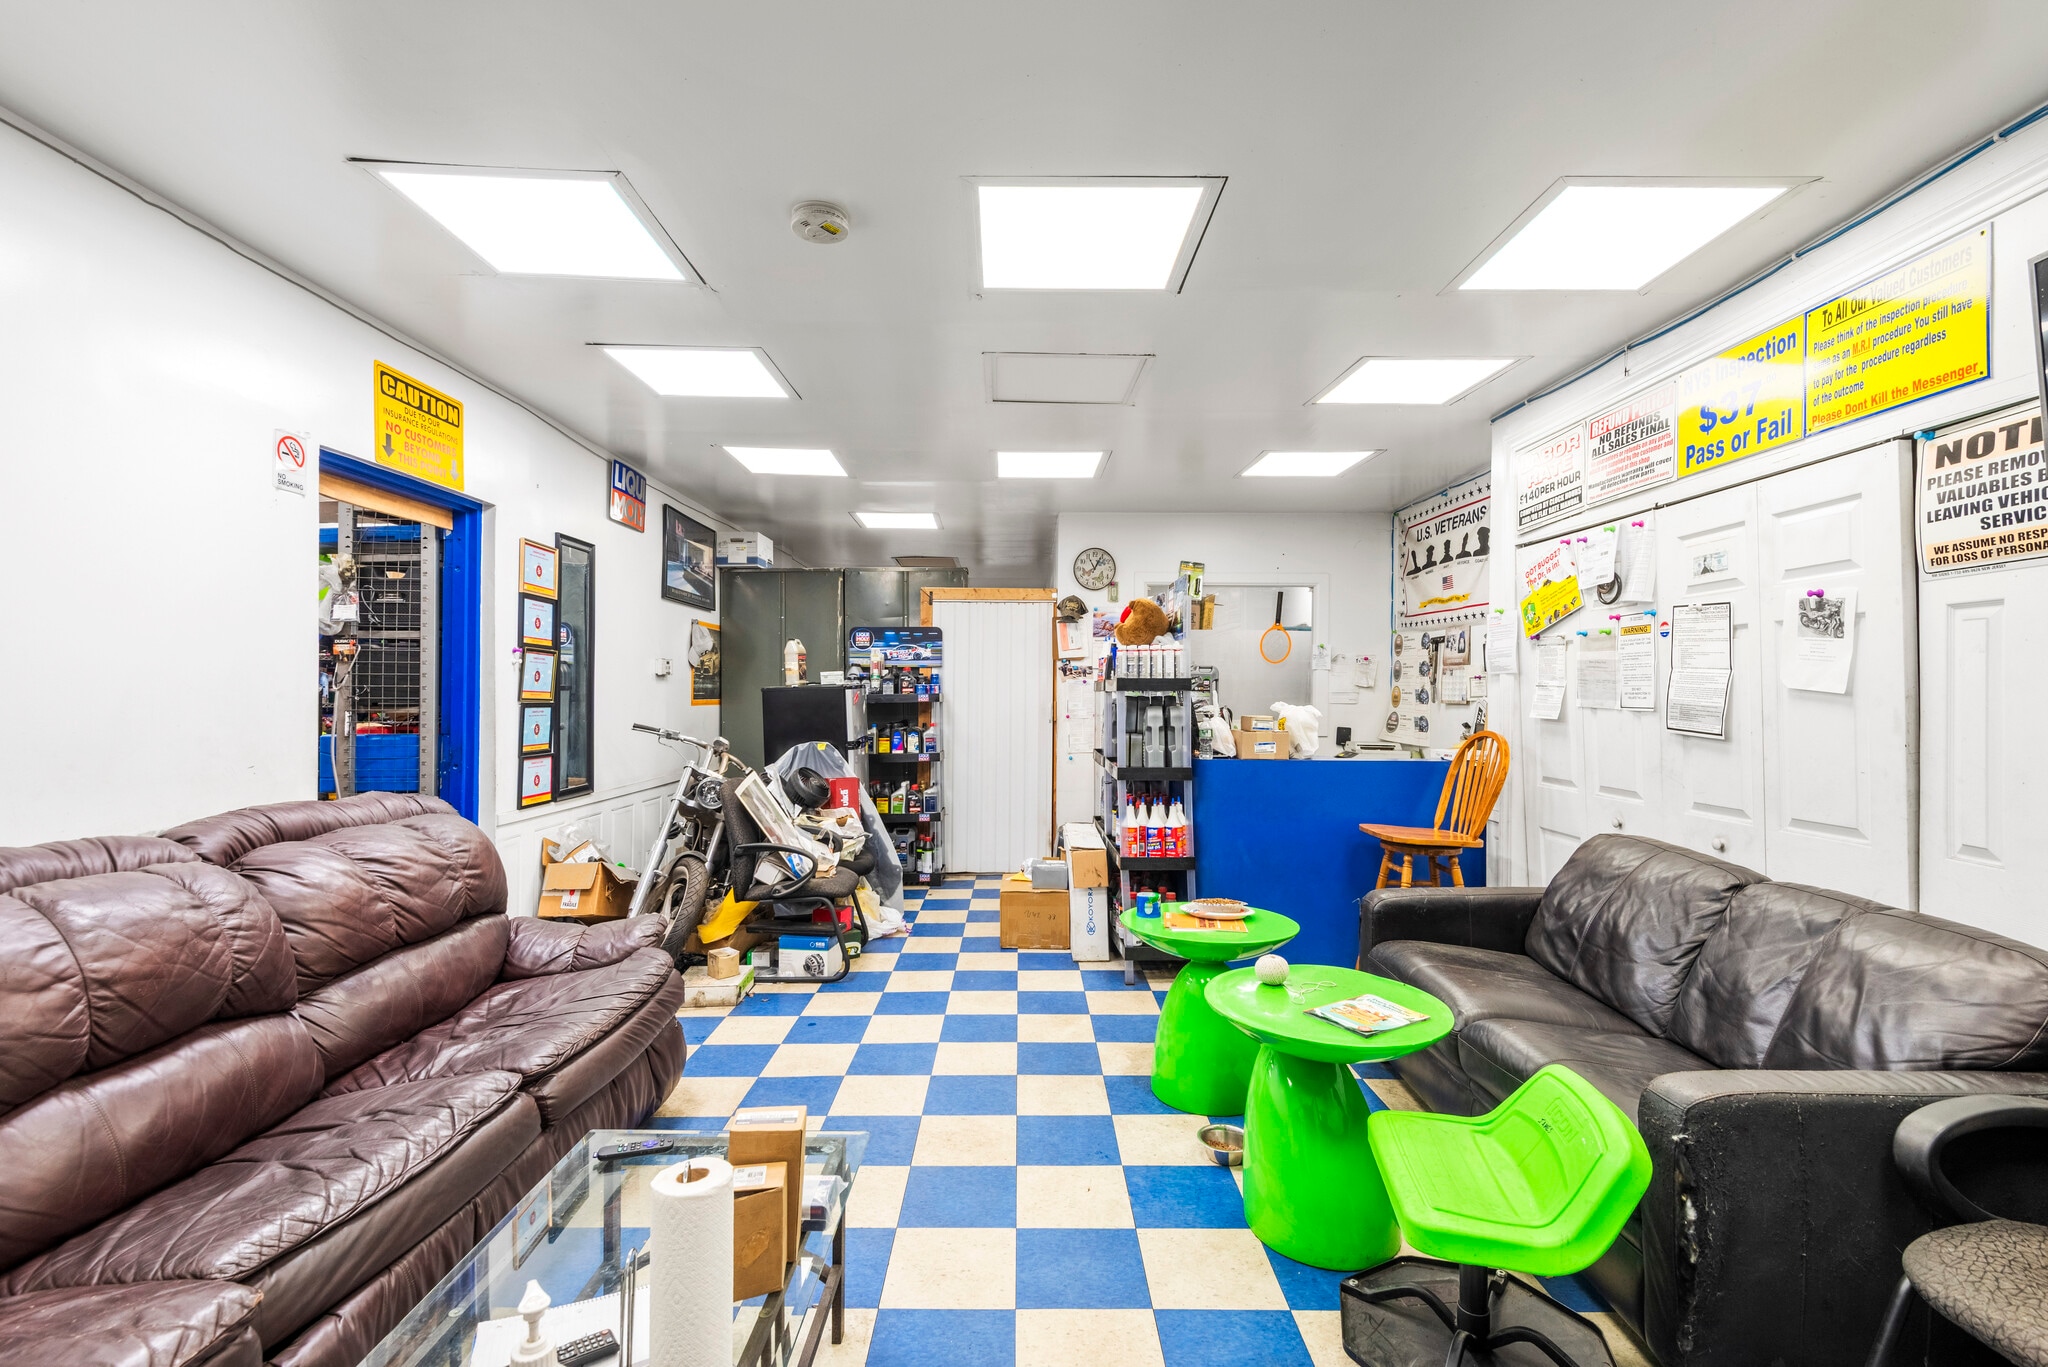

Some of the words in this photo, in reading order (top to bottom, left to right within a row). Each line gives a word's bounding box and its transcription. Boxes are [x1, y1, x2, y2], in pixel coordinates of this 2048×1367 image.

[1823, 309, 1832, 327] To
[1836, 301, 1847, 322] All
[1851, 295, 1867, 316] Our
[1870, 272, 1905, 305] Valued
[1910, 246, 1972, 288] Customers
[1814, 337, 1834, 354] Please
[1837, 327, 1854, 344] think
[1856, 323, 1864, 336] of
[1866, 318, 1878, 331] the
[1879, 299, 1920, 325] inspection
[1923, 279, 1968, 307] procedure
[1832, 354, 1840, 363] as
[1842, 348, 1850, 360] an
[1872, 324, 1912, 350] procedure
[1914, 316, 1930, 331] You
[1932, 306, 1948, 323] still
[1951, 298, 1973, 315] have
[1684, 368, 1711, 396] NYS
[1716, 332, 1796, 382] Inspection
[1814, 380, 1820, 389] to
[1822, 374, 1832, 390] pay
[1835, 370, 1843, 381] for
[1846, 364, 1857, 377] the
[1861, 348, 1899, 373] procedure
[1902, 329, 1947, 357] regardless
[382, 375, 458, 425] CAUTION
[1812, 406, 1842, 427] Please
[1845, 398, 1867, 415] Dont
[1871, 391, 1888, 407] Kill
[1891, 384, 1909, 399] the
[1912, 362, 1978, 393] Messenger
[1813, 394, 1820, 407] of
[1822, 389, 1832, 403] the
[1834, 380, 1864, 399] outcome
[383, 408, 419, 428] INSURANCE
[420, 424, 458, 445] REGULATIONS
[405, 407, 416, 418] DUE
[418, 414, 426, 422] TO
[428, 419, 440, 427] OUR
[1592, 408, 1630, 438] REFUND
[1599, 432, 1612, 445] NO
[1614, 411, 1660, 440] REFUNDS
[385, 420, 402, 435] NO
[405, 429, 456, 457] CUSTOMERS
[1592, 446, 1606, 458] ALL
[1608, 432, 1637, 451] SALES
[1640, 418, 1670, 438] FINAL
[1640, 444, 1663, 457] customer
[1664, 438, 1673, 448] and
[1658, 432, 1671, 442] parts
[1686, 440, 1725, 469] Pass
[1731, 429, 1751, 452] or
[1757, 408, 1792, 444] Fail
[398, 452, 418, 468] THIS
[420, 461, 447, 478] POINT
[404, 442, 441, 463] BEYOND
[1645, 461, 1655, 470] will
[1656, 457, 1672, 466] cover
[278, 479, 303, 490] SMOKING
[615, 463, 645, 501] LIQUI
[1540, 482, 1555, 494] PER
[1557, 471, 1581, 489] HOUR
[1640, 468, 1655, 479] parts
[1927, 465, 1983, 490] PLEASE
[1936, 471, 2032, 505] VALUABLES
[614, 492, 644, 527] MOLY
[1539, 509, 1547, 519] FLAT
[1550, 495, 1564, 505] CLOCK
[1927, 497, 1993, 524] LEAVING
[1416, 525, 1432, 542] U.S.
[1434, 505, 1487, 536] VETERANS
[1980, 505, 2046, 530] SERVIC
[1931, 556, 1949, 566] FOR
[1952, 551, 1978, 563] LOSS
[1981, 549, 1993, 559] OF
[1934, 545, 1950, 555] WE
[1952, 537, 1996, 553] ASSUME
[1999, 534, 2014, 545] NO
[1525, 565, 1536, 579] GOT
[1537, 547, 1561, 570] BUGGZ?
[1526, 577, 1537, 587] The
[1537, 571, 1546, 580] Dr.
[1552, 559, 1560, 570] in!
